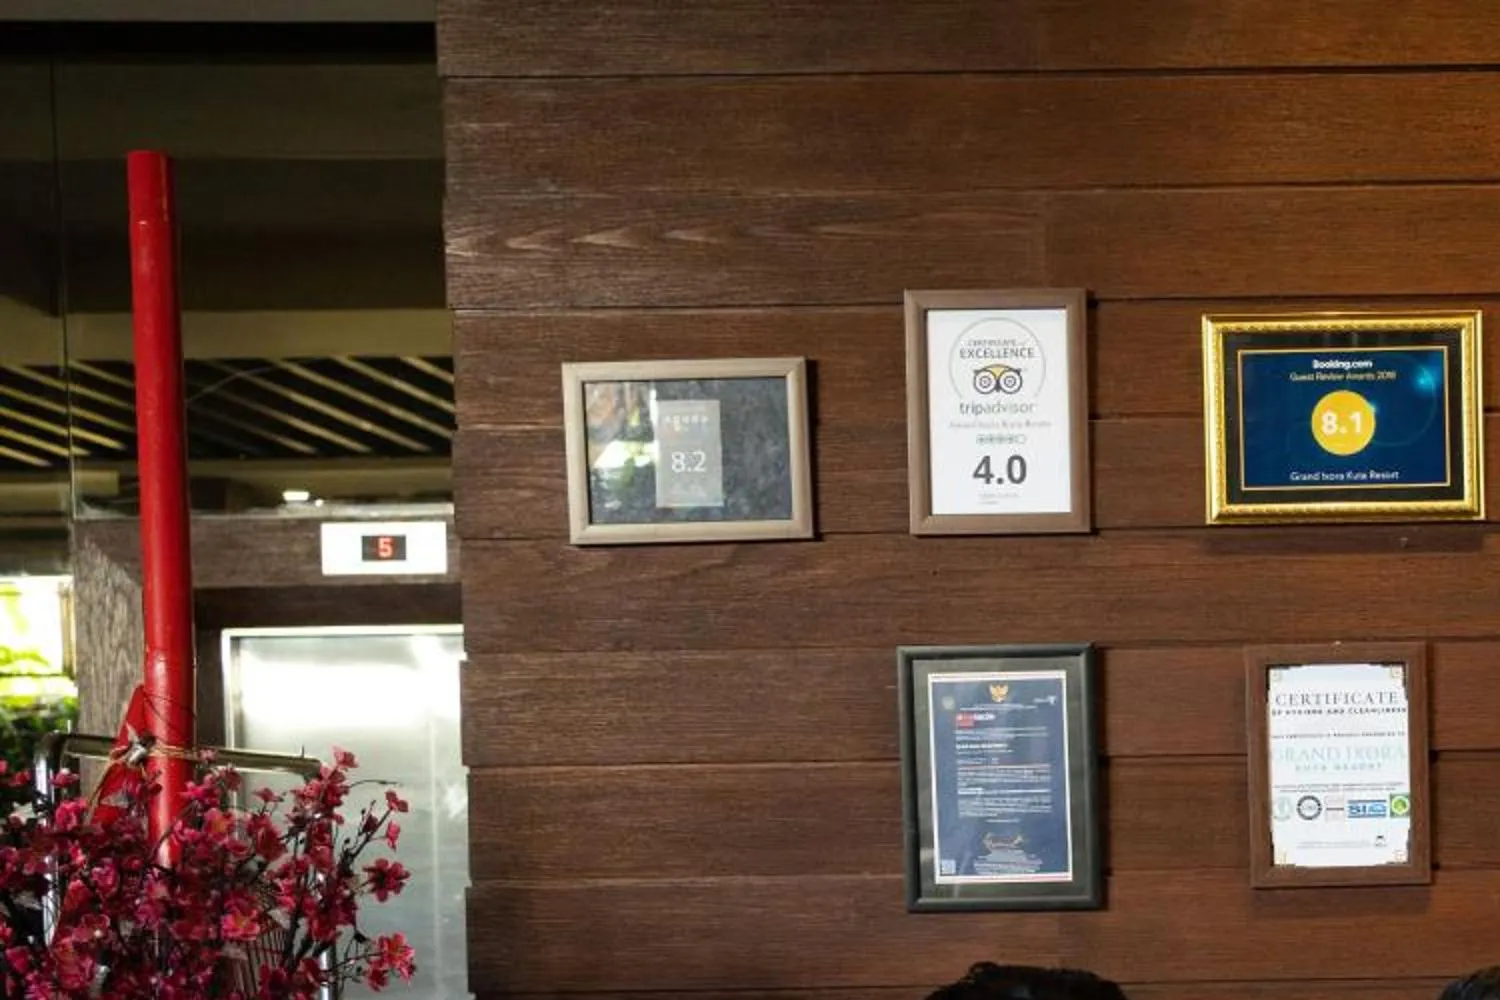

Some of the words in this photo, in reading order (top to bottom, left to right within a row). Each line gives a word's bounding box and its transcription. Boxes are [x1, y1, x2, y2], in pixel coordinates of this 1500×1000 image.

[959, 347, 1034, 359] EXCELLENCE
[1312, 359, 1373, 370] Booking.com
[959, 401, 1035, 416] tripadvisor
[1321, 412, 1364, 435] 8.1
[671, 450, 707, 473] 8.2
[973, 454, 1027, 485] 4.0
[377, 537, 394, 557] 5
[1275, 691, 1398, 706] CERTIFICATE
[1277, 745, 1341, 763] RAND
